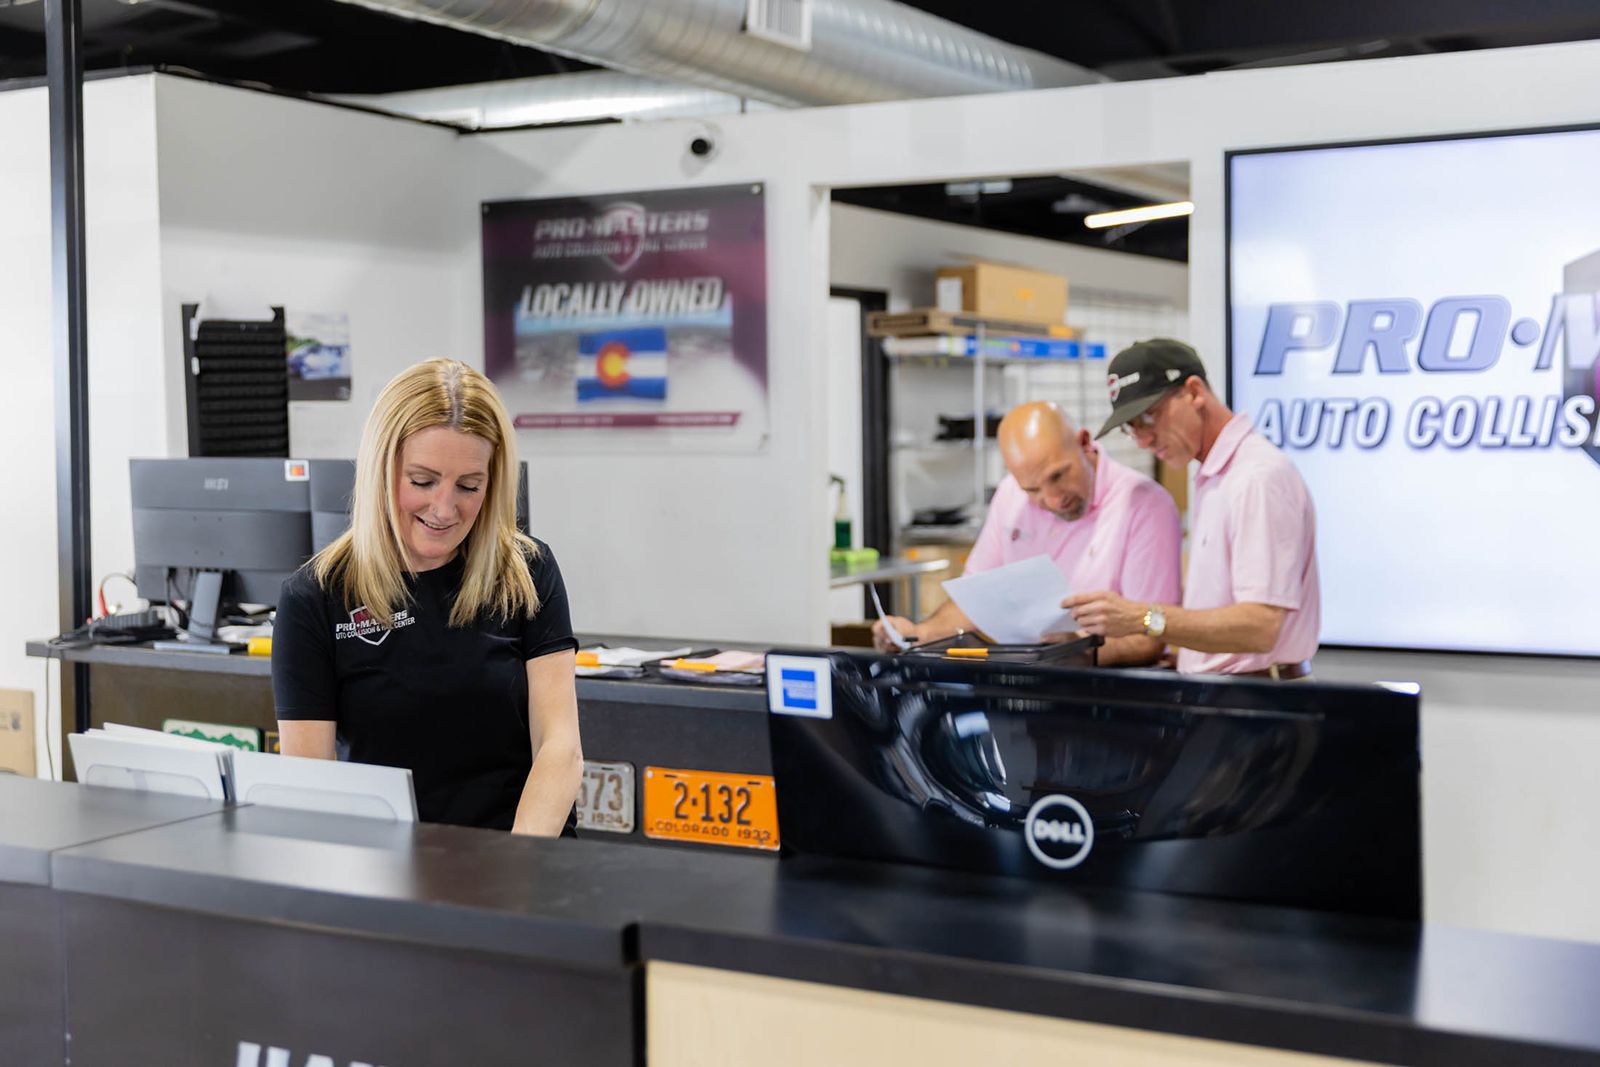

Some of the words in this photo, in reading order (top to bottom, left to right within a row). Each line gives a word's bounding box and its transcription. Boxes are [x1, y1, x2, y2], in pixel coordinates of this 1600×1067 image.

[521, 281, 626, 320] LOCALLY
[629, 277, 724, 313] OWNED
[1254, 397, 1391, 449] AUTO
[1406, 394, 1600, 449] COLLIS
[335, 631, 347, 640] UTO
[394, 616, 416, 628] CENTER
[655, 819, 730, 837] COLORADO
[1034, 819, 1086, 844] DELL
